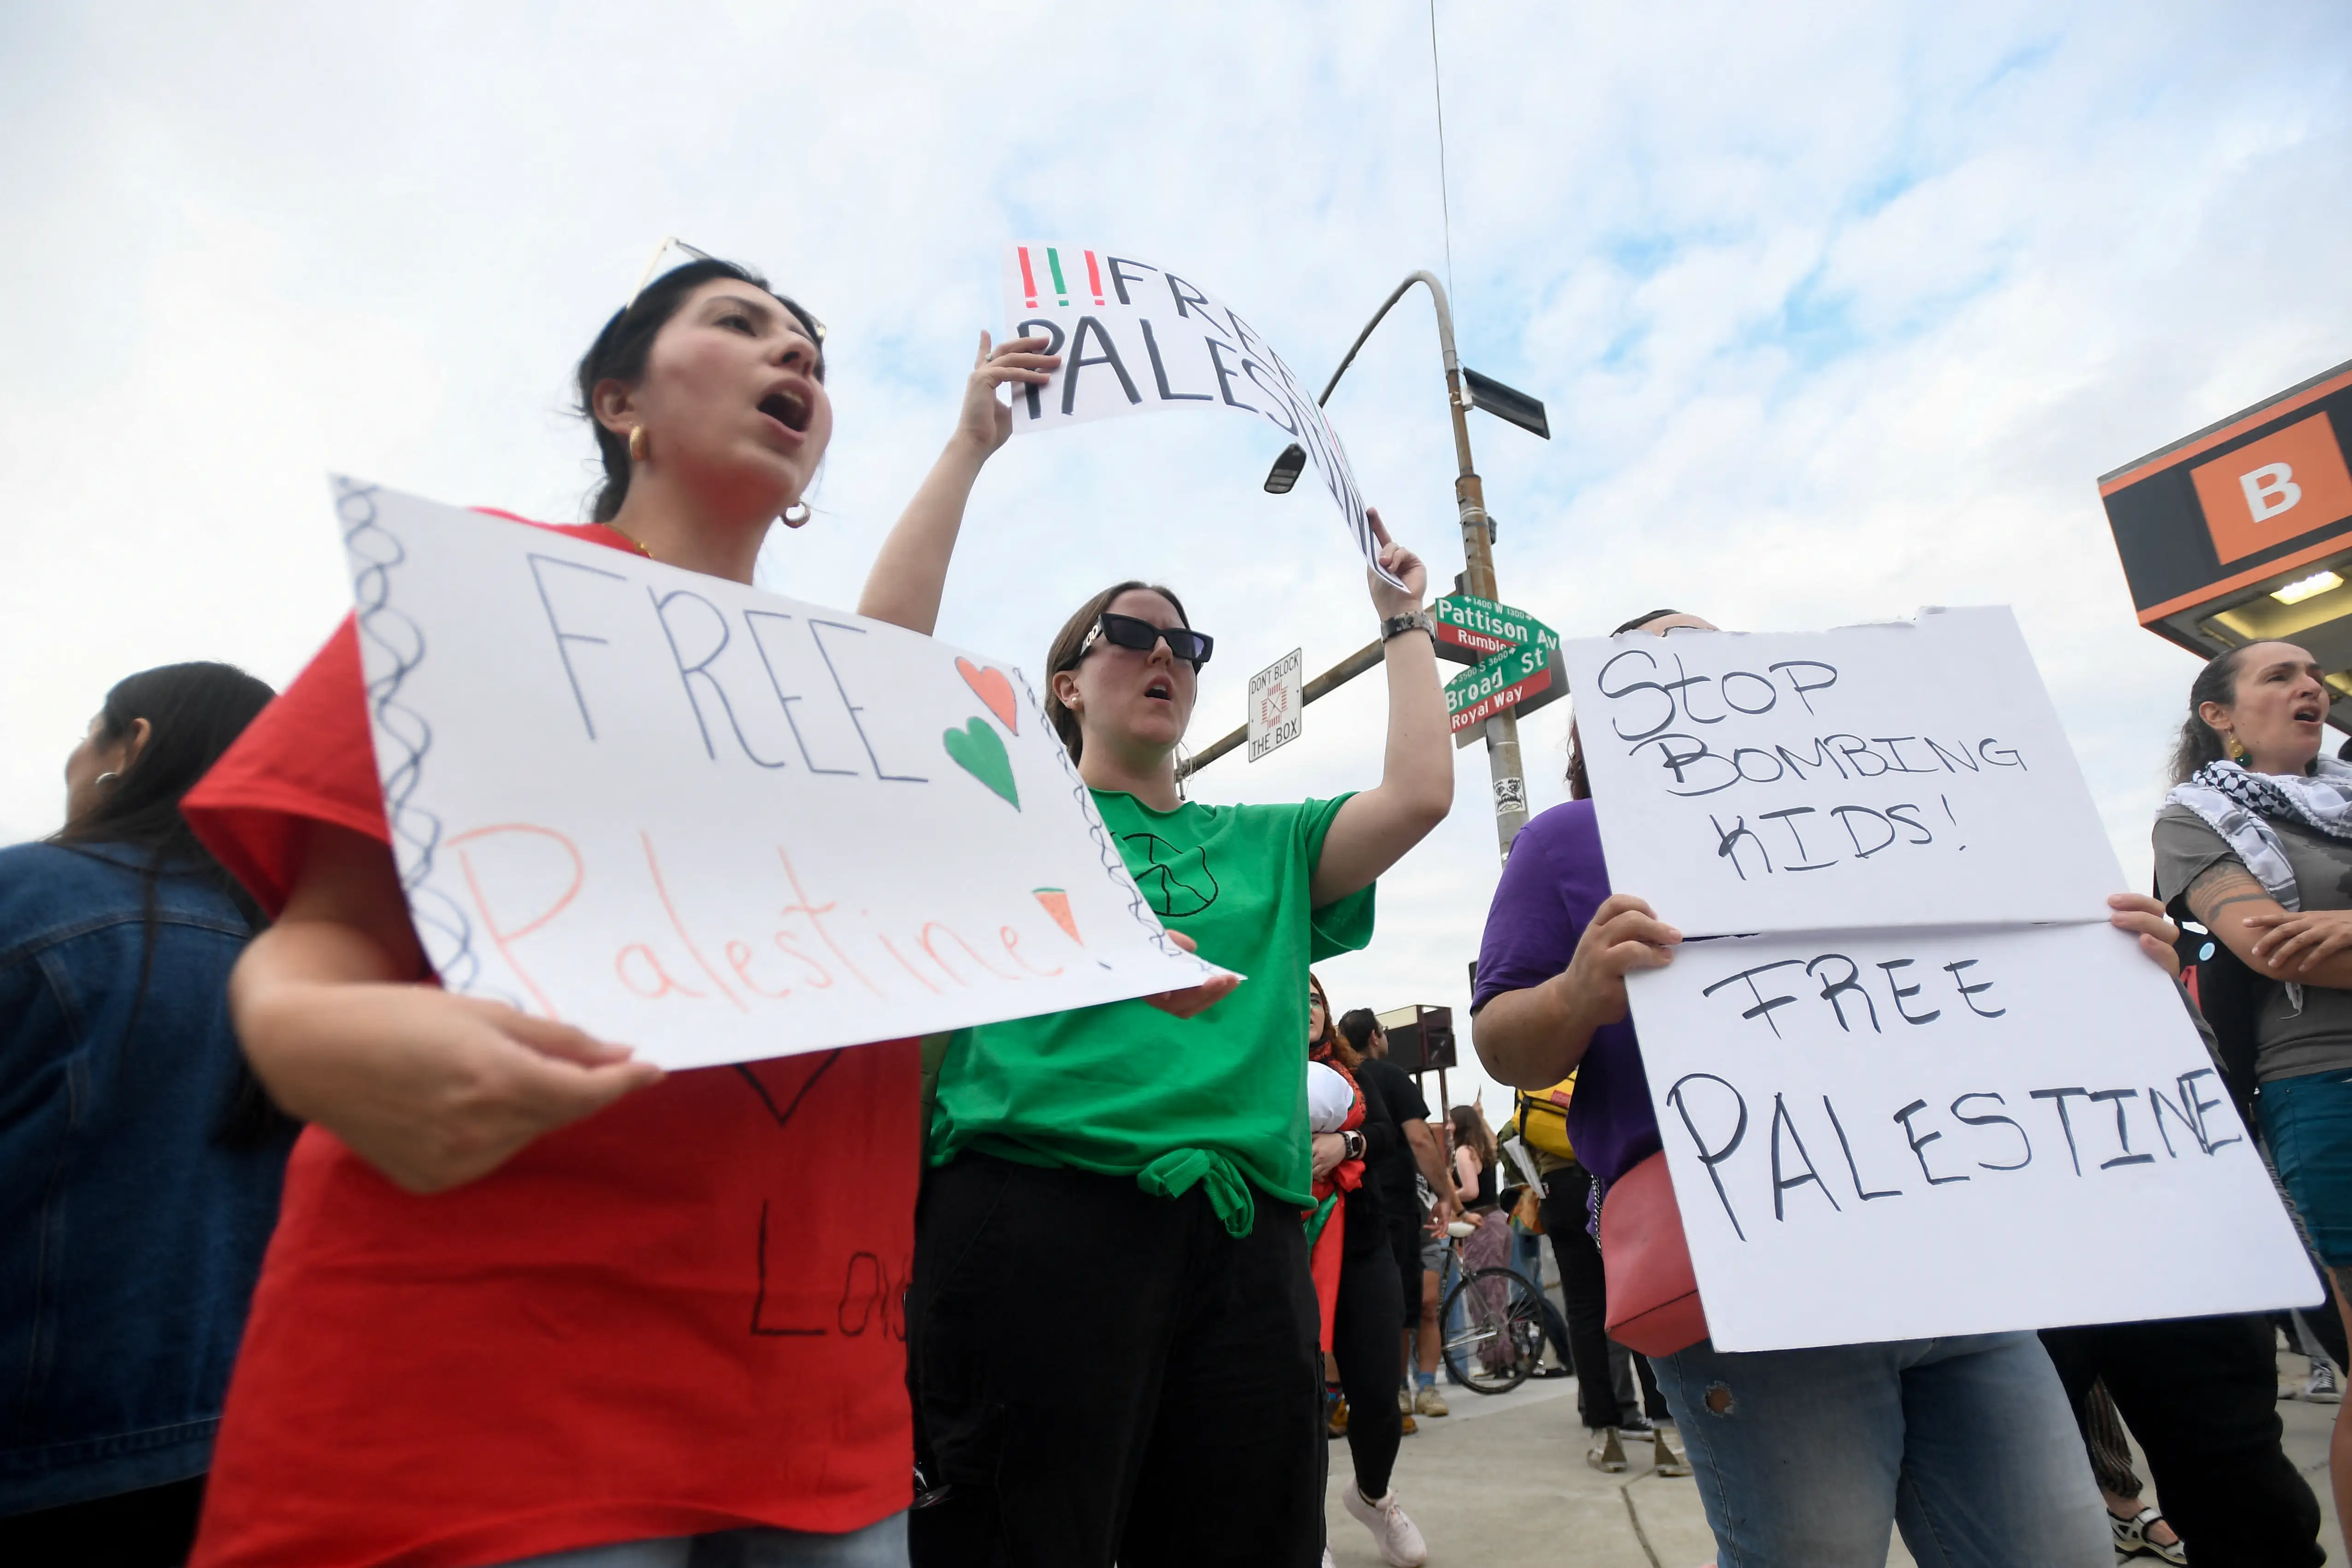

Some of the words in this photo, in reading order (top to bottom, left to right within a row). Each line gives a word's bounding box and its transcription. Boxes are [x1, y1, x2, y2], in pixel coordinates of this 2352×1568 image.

[2239, 461, 2303, 524] B
[1438, 598, 1529, 643] Pattison
[1473, 598, 1492, 610] 1400
[1494, 602, 1503, 614] W
[1507, 607, 1526, 619] 1300
[526, 552, 929, 784] FREE
[1274, 653, 1299, 680] BLOCK
[1444, 666, 1503, 712] Broad
[1521, 647, 1544, 673] St
[1458, 666, 1477, 683] 3500
[1479, 661, 1486, 672] S
[1488, 649, 1509, 666] 3600
[1252, 733, 1271, 757] THE
[1276, 717, 1297, 744] BOX
[1452, 700, 1489, 730] Royal
[1493, 685, 1523, 708] Way
[1629, 733, 2028, 796] BOMBING
[1709, 794, 1967, 881] KIDS!
[1703, 954, 2006, 1039] FREE
[1666, 1068, 2242, 1243] PALESTINE
